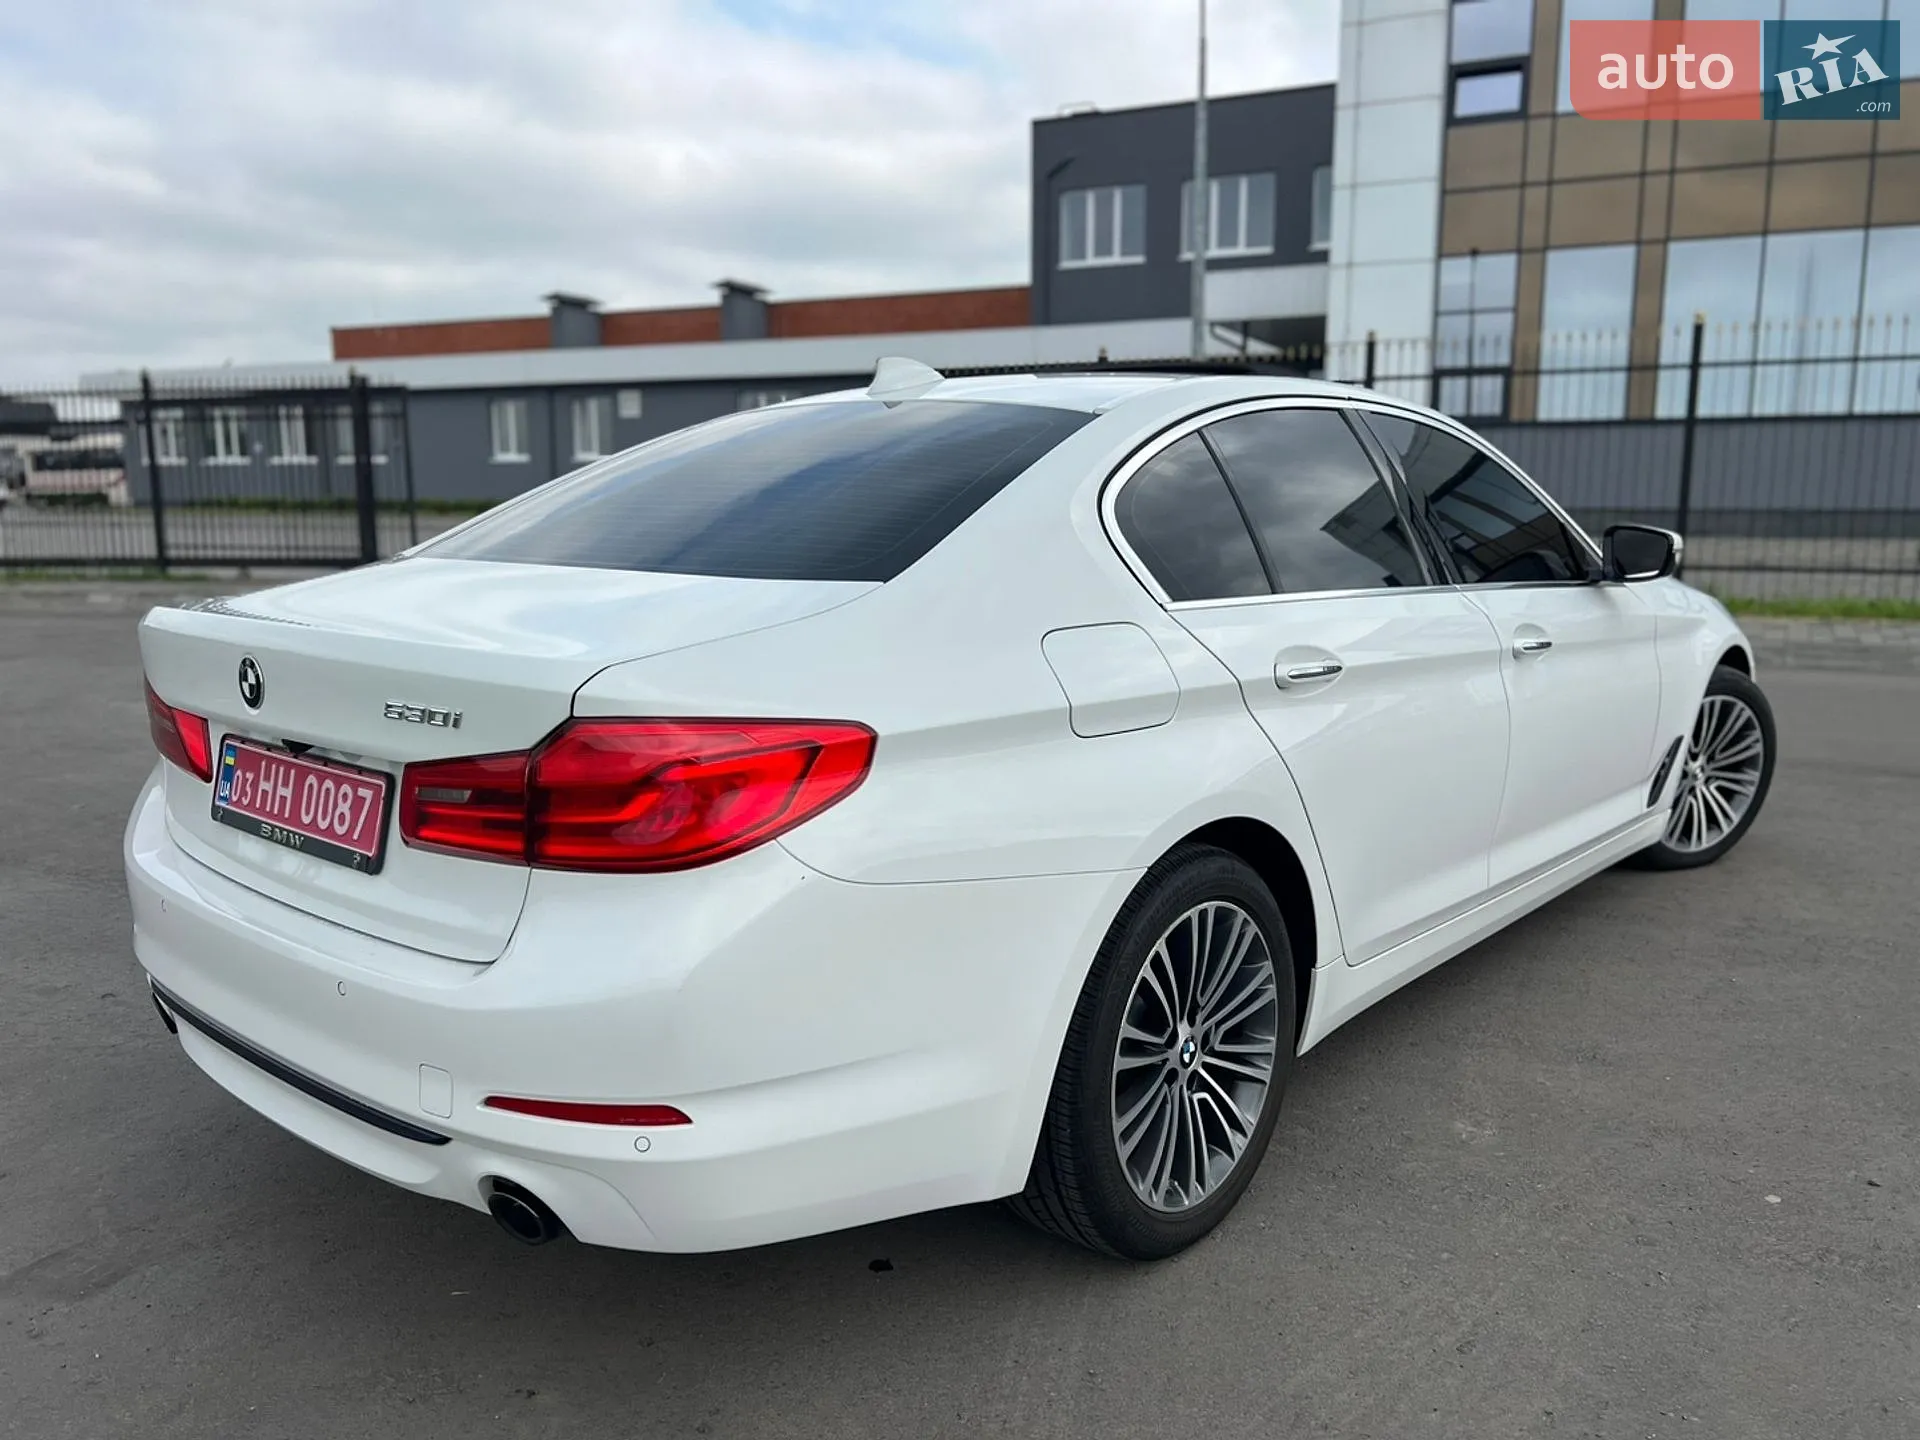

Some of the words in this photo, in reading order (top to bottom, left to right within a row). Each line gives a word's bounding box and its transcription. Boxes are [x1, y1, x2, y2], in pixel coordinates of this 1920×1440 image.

[383, 700, 463, 729] 530i
[231, 769, 254, 806] 03
[256, 760, 296, 819] HH
[300, 774, 374, 841] 0087
[260, 823, 305, 849] BMW
